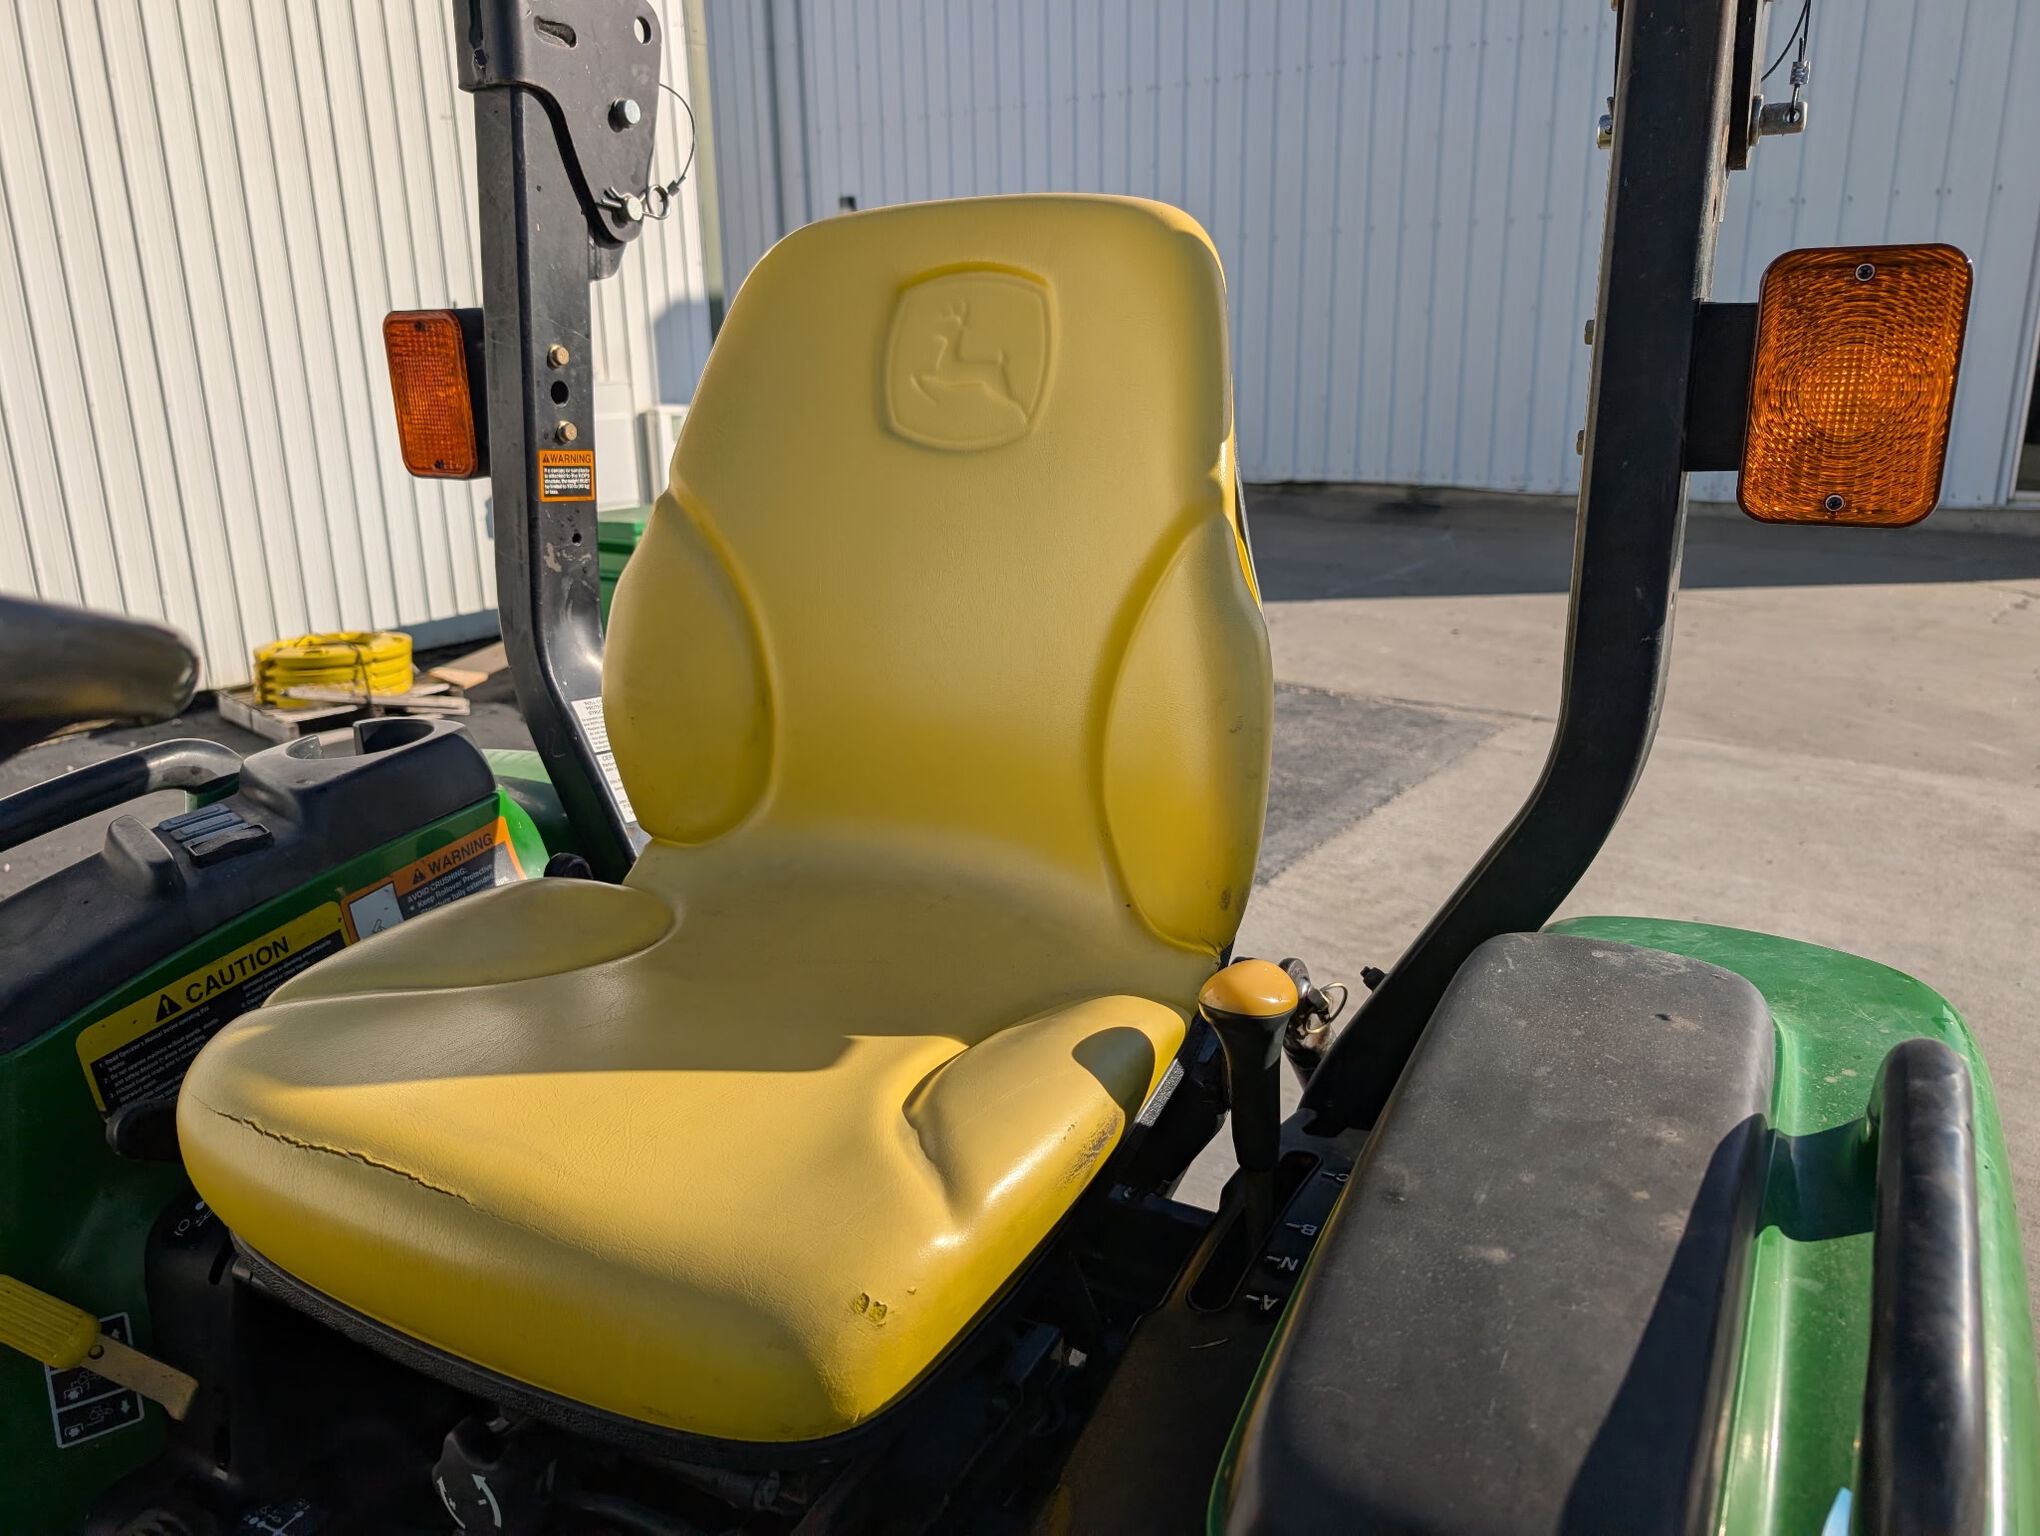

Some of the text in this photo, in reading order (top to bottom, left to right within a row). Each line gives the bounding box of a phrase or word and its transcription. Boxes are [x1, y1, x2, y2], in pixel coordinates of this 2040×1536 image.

[550, 454, 591, 463] WARNING
[428, 833, 493, 874] WARNING
[407, 884, 430, 903] AVOID
[417, 894, 436, 908] Keep
[435, 881, 462, 898] Rollover
[462, 864, 494, 884] Protective
[185, 935, 290, 1004] CAUTION
[1301, 1224, 1318, 1236] B
[1279, 1256, 1299, 1271] N
[1263, 1294, 1280, 1310] A
